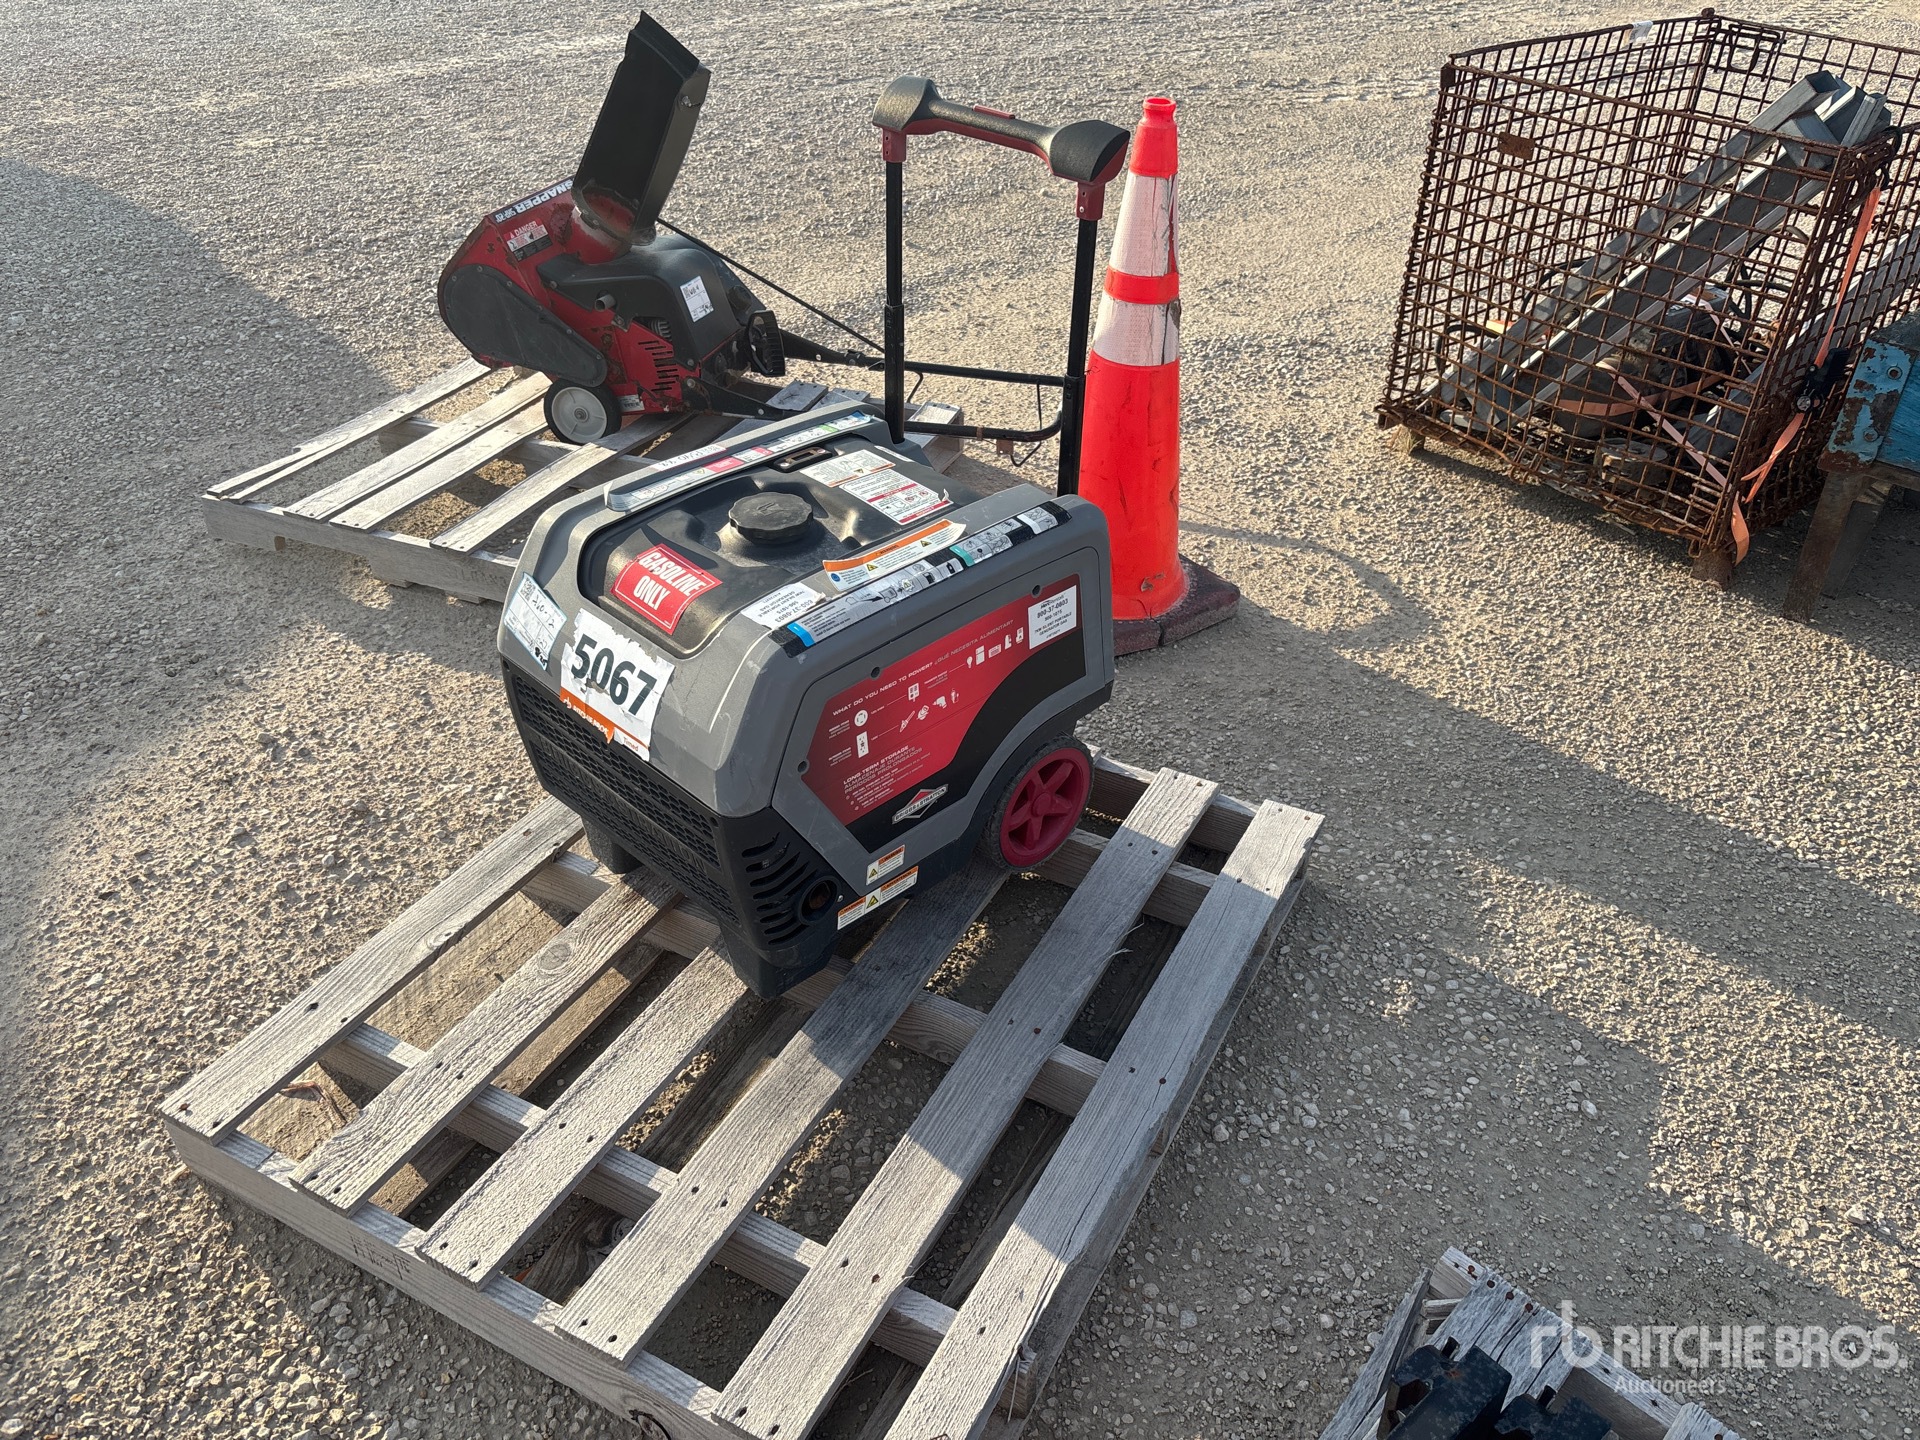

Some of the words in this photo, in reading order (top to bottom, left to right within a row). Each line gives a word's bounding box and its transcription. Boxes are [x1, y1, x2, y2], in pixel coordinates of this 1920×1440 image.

[513, 179, 574, 214] SNAPPER
[514, 221, 538, 236] DANGER
[634, 575, 671, 611] ONLY
[639, 551, 707, 597] GASOLINE
[571, 634, 657, 716] 5067
[833, 704, 851, 716] WHAT
[853, 697, 863, 707] DO
[865, 690, 878, 701] YOU
[880, 680, 897, 693] NEED
[908, 662, 933, 678] POWER?
[843, 762, 879, 785] LONG-TERM
[880, 745, 909, 764] STORAGE
